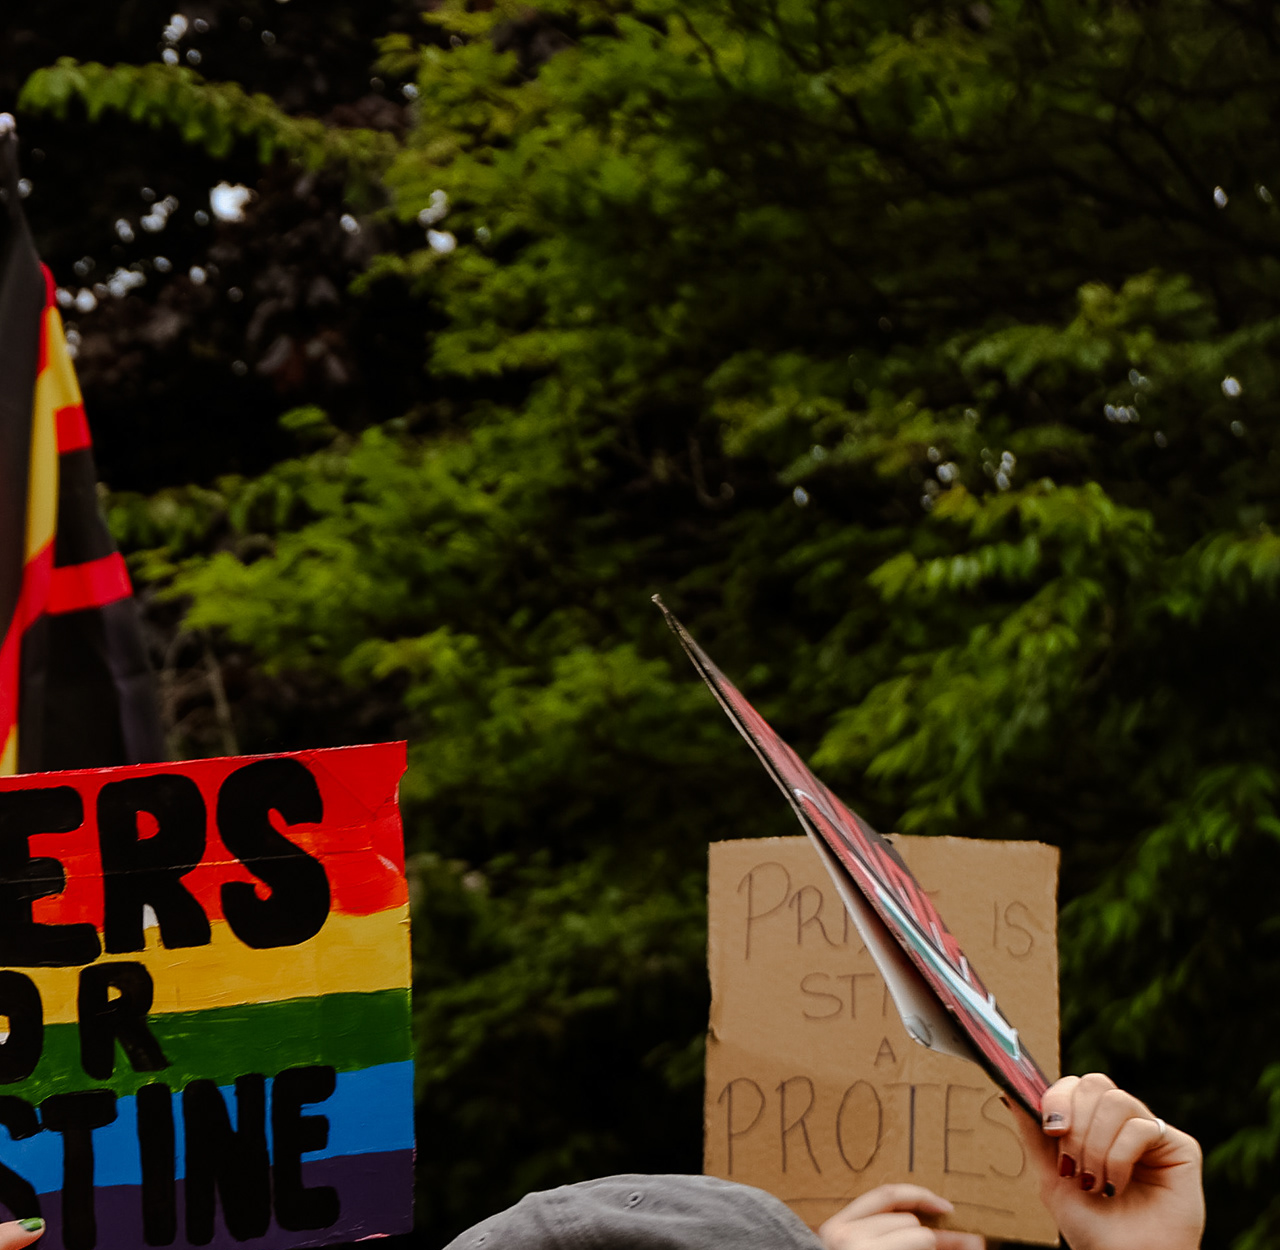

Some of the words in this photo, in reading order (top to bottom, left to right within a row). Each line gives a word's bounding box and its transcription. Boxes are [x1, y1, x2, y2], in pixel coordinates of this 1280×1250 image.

[993, 900, 1034, 958] IS
[874, 1037, 897, 1067] A
[718, 1075, 1026, 1179] PROTES
